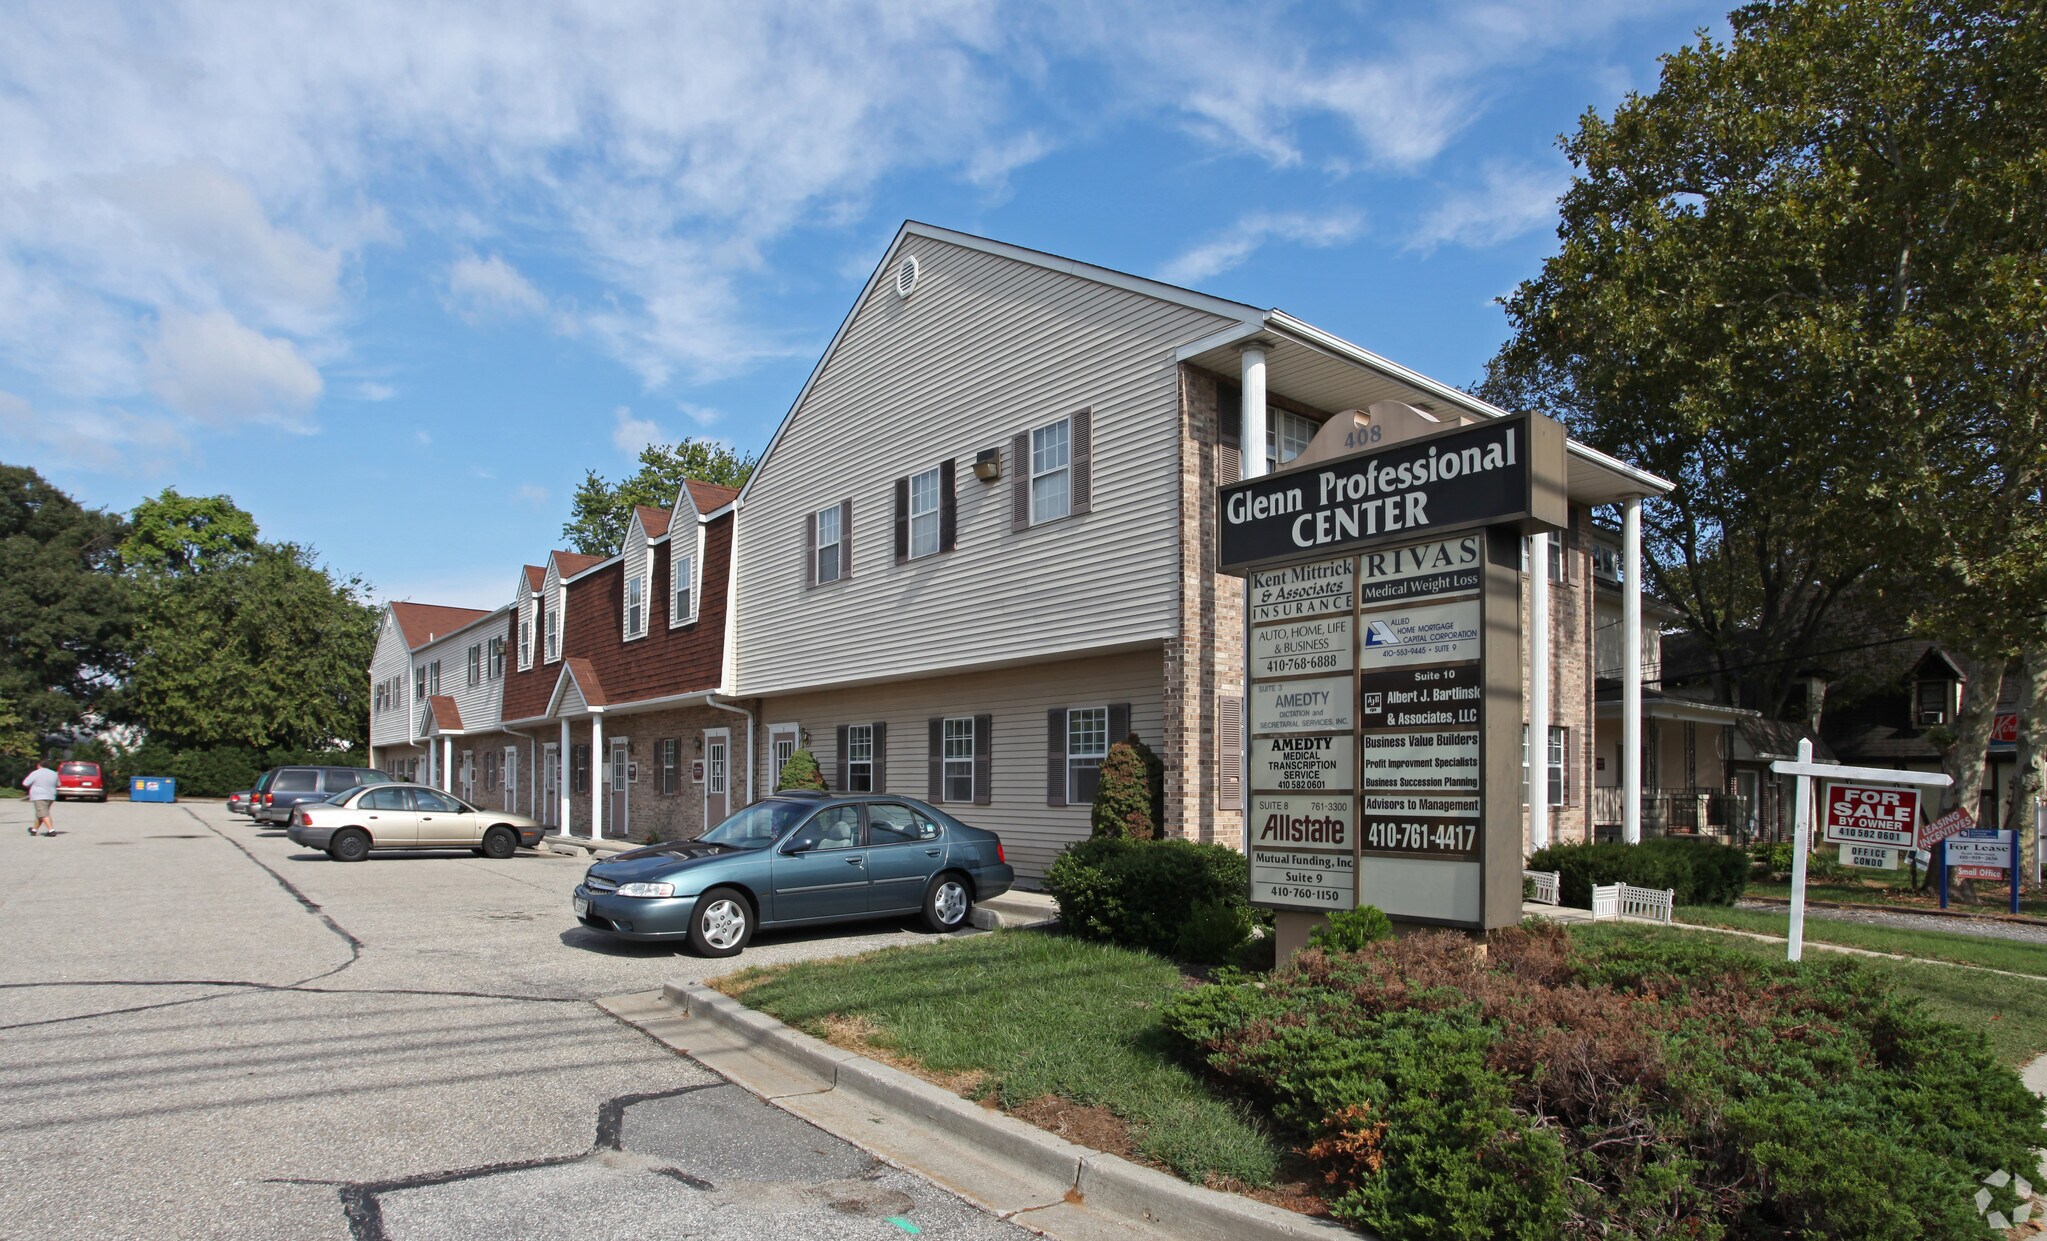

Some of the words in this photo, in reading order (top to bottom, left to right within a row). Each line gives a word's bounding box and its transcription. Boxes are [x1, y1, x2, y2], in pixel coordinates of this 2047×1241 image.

[1344, 424, 1382, 448] 408
[1227, 490, 1303, 524] Glenn
[1319, 427, 1516, 506] Professional
[1292, 491, 1429, 547] CENTER
[1366, 537, 1477, 578] RIVAS
[1253, 571, 1287, 589] Kent
[1291, 559, 1352, 583] Mittrick
[1261, 589, 1273, 603] &
[1275, 581, 1343, 601] Associates
[1365, 581, 1407, 599] Medical
[1410, 577, 1450, 593] Weight
[1454, 575, 1478, 587] Loss
[1253, 595, 1352, 619] INSURANCE
[1390, 617, 1410, 626] ALLIED
[1397, 626, 1415, 634] HOME
[1418, 622, 1454, 632] MORTGAGE
[1259, 628, 1289, 642] AUTO,
[1291, 624, 1325, 638] HOME,
[1327, 621, 1346, 634] LIFE
[1402, 635, 1427, 643] CAPITAL
[1429, 629, 1477, 640] CORPORATION
[1274, 643, 1282, 654] &
[1284, 638, 1329, 653] BUSINESS
[1434, 644, 1450, 653] SUITE
[1267, 654, 1337, 672] 410-768-6888
[1414, 672, 1440, 682] Suite
[1443, 670, 1456, 679] 10
[1258, 685, 1276, 693] SUITE
[1387, 690, 1418, 704] Albert
[1420, 689, 1430, 702] J.
[1275, 691, 1330, 708] AMEDTY
[1279, 710, 1310, 718] DICTATION
[1387, 713, 1396, 726] &
[1398, 711, 1456, 725] Associates,
[1458, 708, 1477, 722] LLC
[1260, 720, 1299, 729] SECRETARIAL
[1271, 737, 1333, 752] AMEDTY
[1365, 736, 1406, 749] Business
[1409, 735, 1434, 747] Value
[1436, 733, 1478, 746] Builders
[1283, 751, 1320, 760] MEDICAL
[1366, 758, 1386, 768] Profit
[1388, 758, 1433, 769] Improvment
[1435, 757, 1478, 769] Specialists
[1268, 760, 1337, 770] TRANSCRIPTION
[1283, 770, 1320, 780] SERVICE
[1366, 778, 1398, 787] Business
[1400, 777, 1442, 787] Succession
[1444, 777, 1478, 788] Planning
[1278, 781, 1290, 789] 410
[1291, 780, 1305, 789] 582
[1306, 780, 1325, 789] 0601
[1366, 798, 1405, 810] Advisors
[1408, 799, 1417, 810] to
[1419, 799, 1479, 812] Management
[1844, 789, 1900, 806] FOR
[1259, 801, 1282, 810] SUITE
[1283, 802, 1289, 810] 8
[1311, 802, 1347, 811] 761-3300
[1833, 801, 1911, 822] SALE
[1260, 814, 1345, 844] Allstate
[1838, 816, 1855, 826] BY
[1858, 818, 1903, 830] OWNER
[1921, 811, 1960, 836] LEASING
[1368, 822, 1476, 850] 410-761-4417
[1839, 828, 1856, 837] 410
[1858, 830, 1875, 839] 582
[1877, 832, 1900, 842] 0601
[1919, 816, 1972, 848] INCENTIVES
[1852, 847, 1886, 858] OFFICE
[1949, 843, 1969, 851] For
[1974, 844, 2009, 853] Lease
[1256, 853, 1289, 864] Mutual
[1291, 855, 1335, 869] Funding,
[1854, 857, 1883, 867] CONDO
[1286, 871, 1313, 883] Suite
[1316, 874, 1323, 884] 9
[1958, 868, 1977, 876] Small
[1980, 869, 2001, 878] Office
[1271, 886, 1339, 901] 410-760-1150
